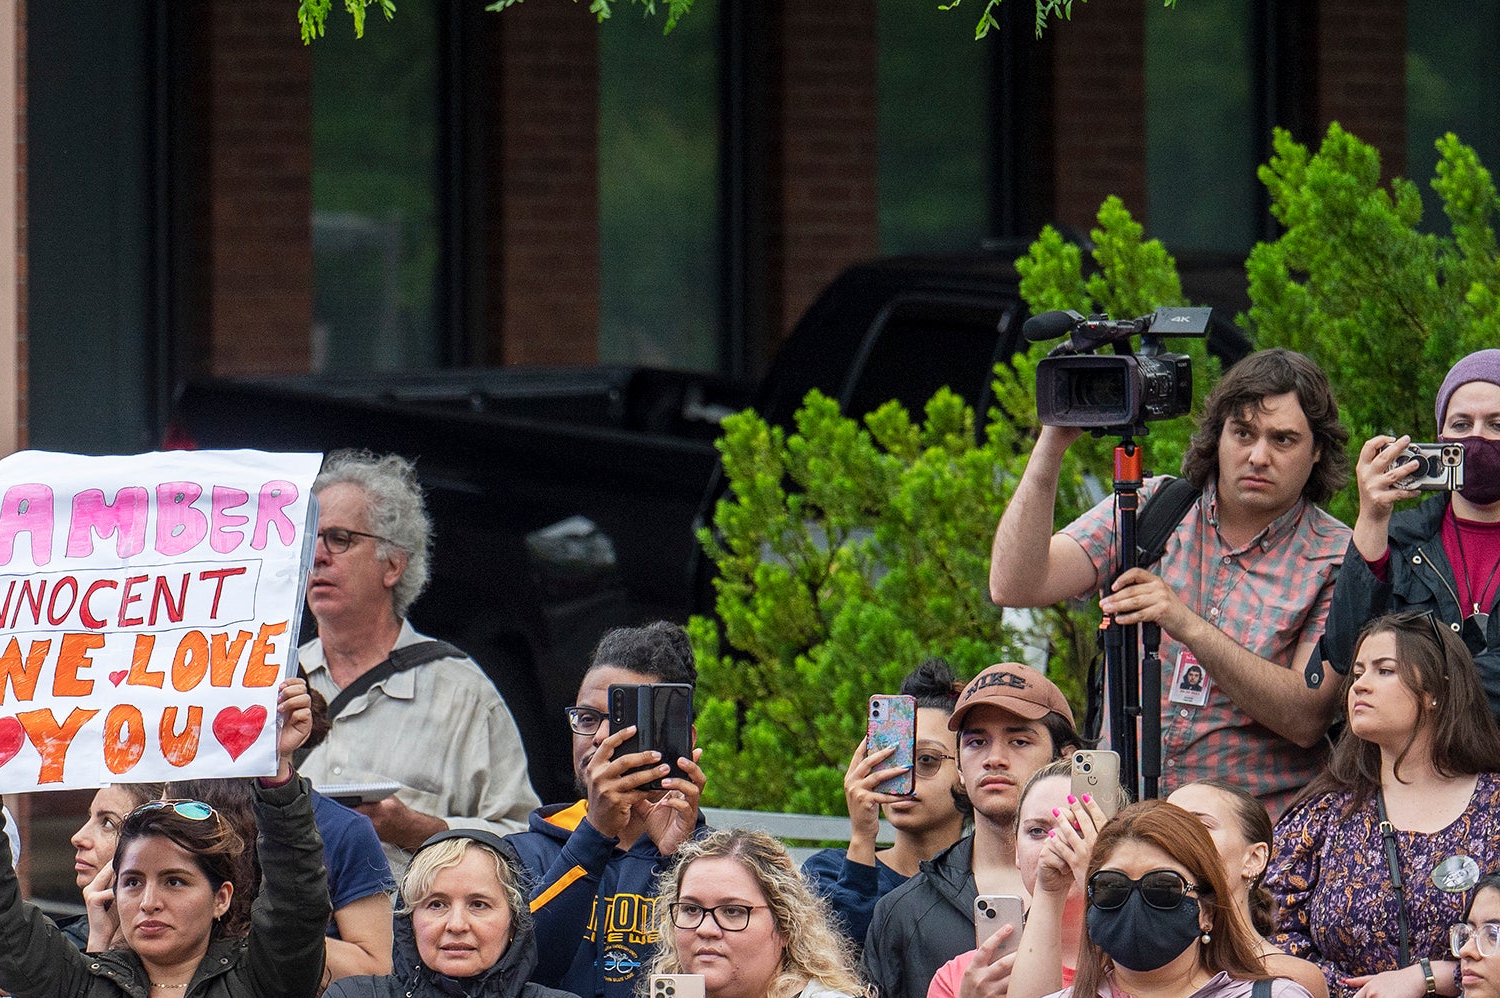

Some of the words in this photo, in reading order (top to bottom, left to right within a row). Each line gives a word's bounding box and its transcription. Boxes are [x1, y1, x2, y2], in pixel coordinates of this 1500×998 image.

[127, 620, 288, 692] LOVE
[965, 672, 1026, 700] NIKE
[16, 705, 203, 784] YOU
